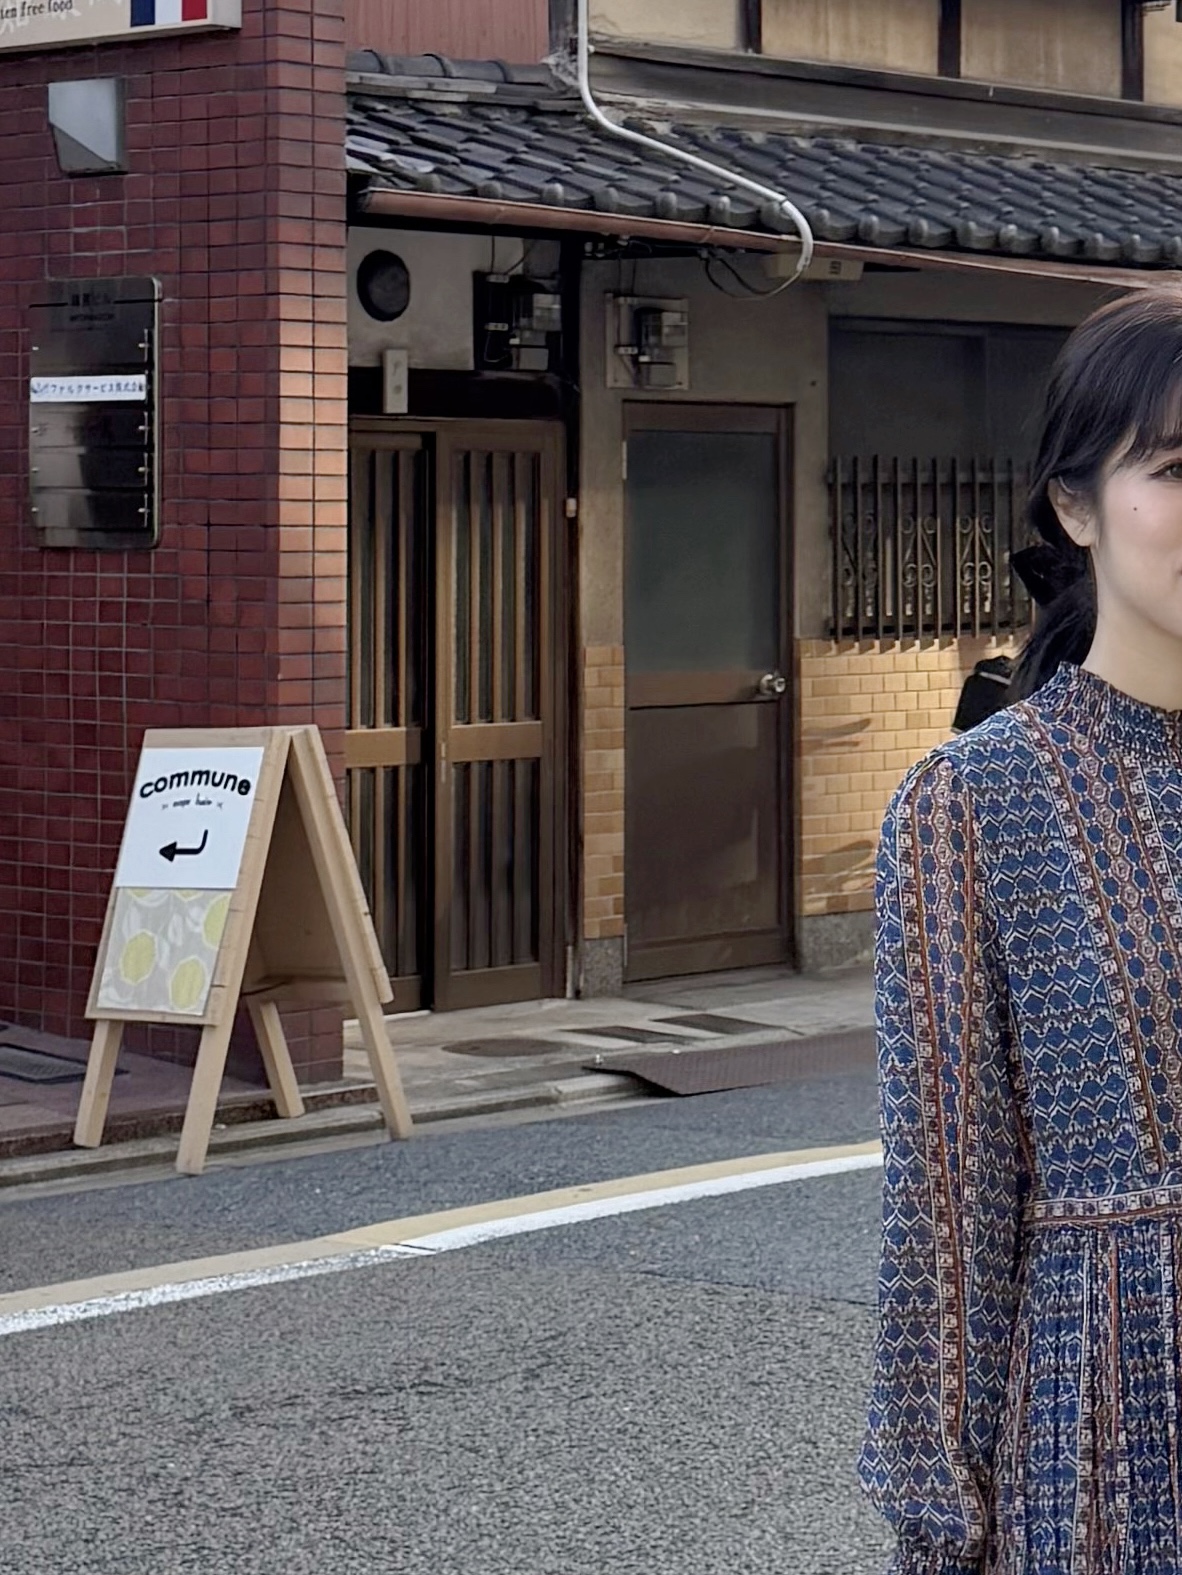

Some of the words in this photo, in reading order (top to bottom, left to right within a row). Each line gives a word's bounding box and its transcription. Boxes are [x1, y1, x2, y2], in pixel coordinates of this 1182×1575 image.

[20, 1, 45, 17] free
[47, 0, 73, 13] food
[139, 769, 251, 798] commune
